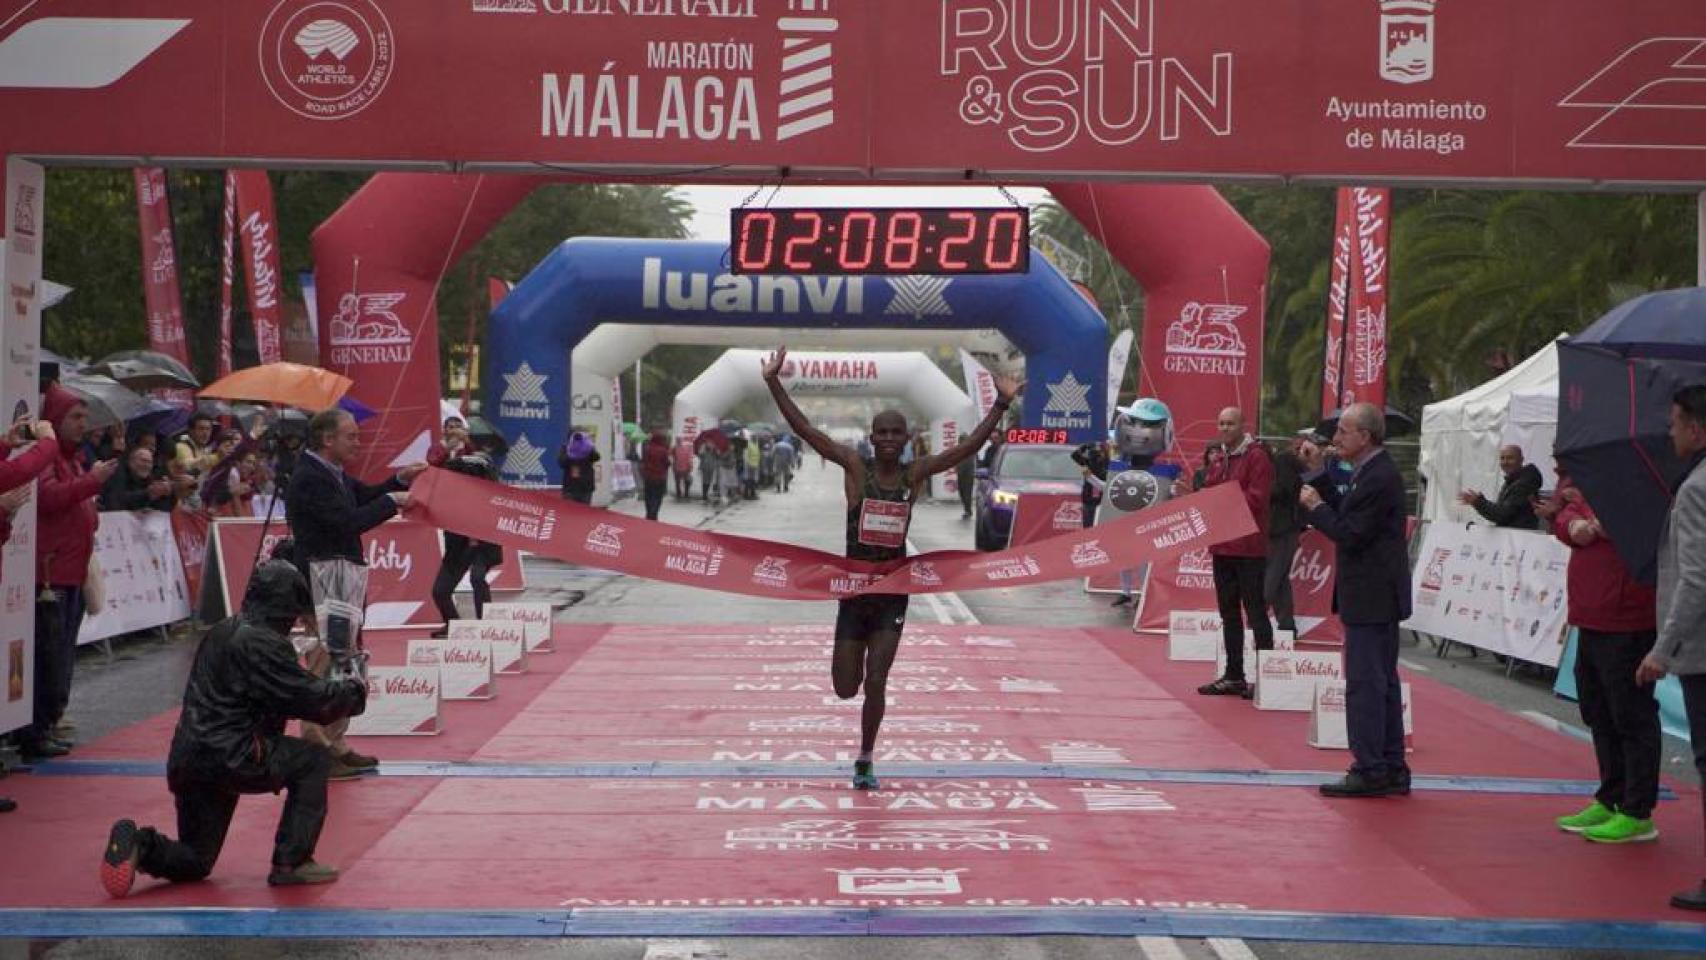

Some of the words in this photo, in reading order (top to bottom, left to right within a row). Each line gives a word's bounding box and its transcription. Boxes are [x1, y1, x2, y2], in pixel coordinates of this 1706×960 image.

[941, 0, 1154, 75] RUN
[646, 38, 754, 71] MARATÓN
[297, 74, 355, 84] ATHLETICS
[307, 64, 347, 75] WORLD
[542, 60, 761, 141] MÁLAGA
[1326, 97, 1488, 122] Ayuntamiento
[1345, 129, 1375, 149] de
[1382, 128, 1465, 155] Málaga
[738, 212, 1023, 271] 02:08:20
[331, 346, 412, 364] GENERALI
[1163, 354, 1247, 376] GENERALI
[799, 359, 879, 380] YAMAHA
[501, 402, 549, 420] luanvi
[1043, 412, 1093, 430] luanvi
[443, 645, 487, 667] Vitality
[1294, 656, 1341, 680] Vitality
[385, 674, 437, 699] Vitality
[966, 898, 1030, 906] de
